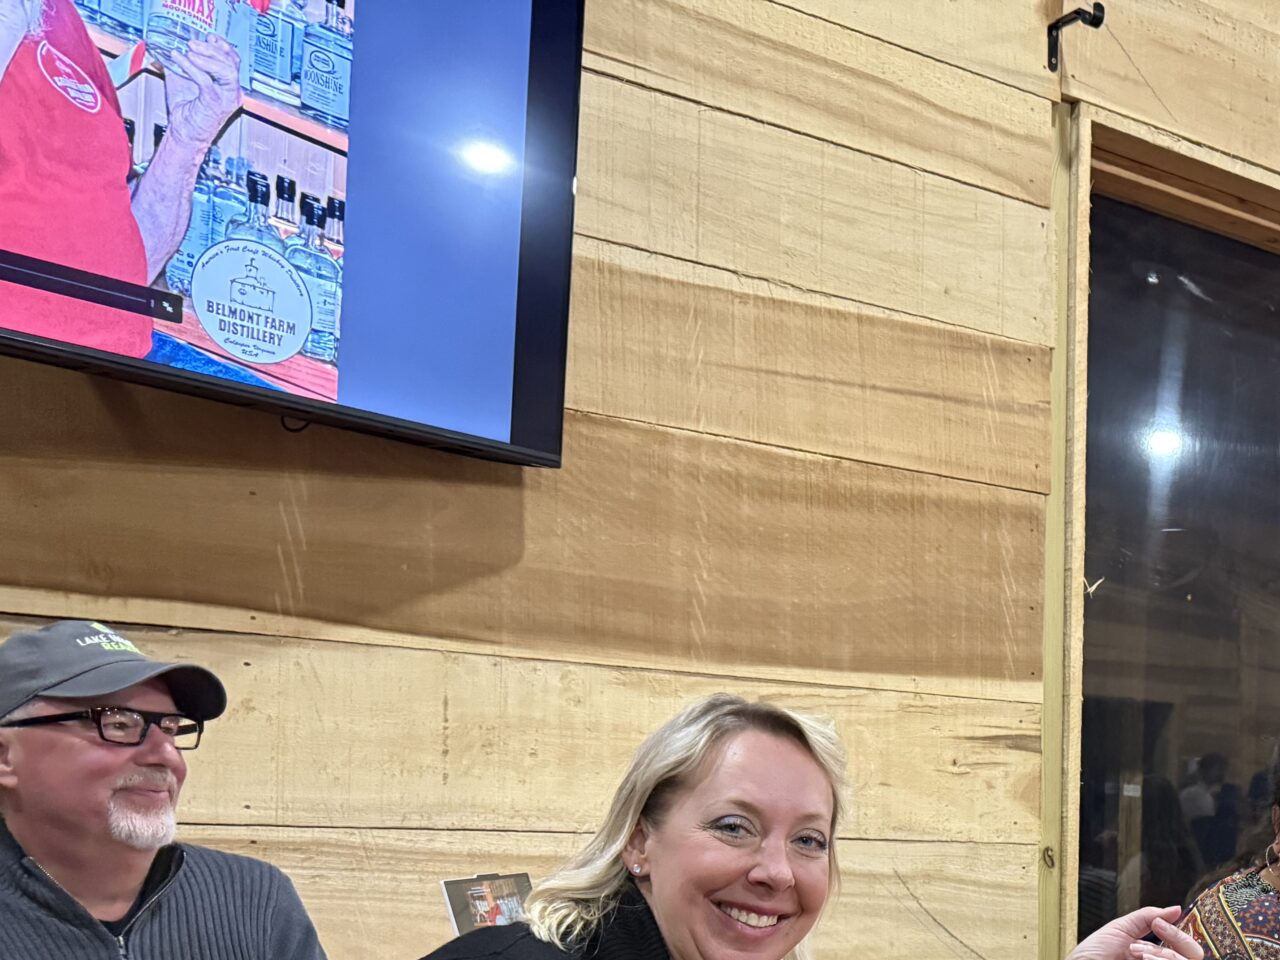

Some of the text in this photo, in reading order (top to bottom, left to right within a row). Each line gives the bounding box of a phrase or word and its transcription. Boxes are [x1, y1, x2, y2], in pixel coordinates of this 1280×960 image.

[162, 2, 213, 29] MOONSHINE
[206, 299, 263, 327] BELMONT
[263, 315, 297, 336] FARM
[218, 318, 284, 347] DISTILLERY
[76, 633, 110, 646] LAKE
